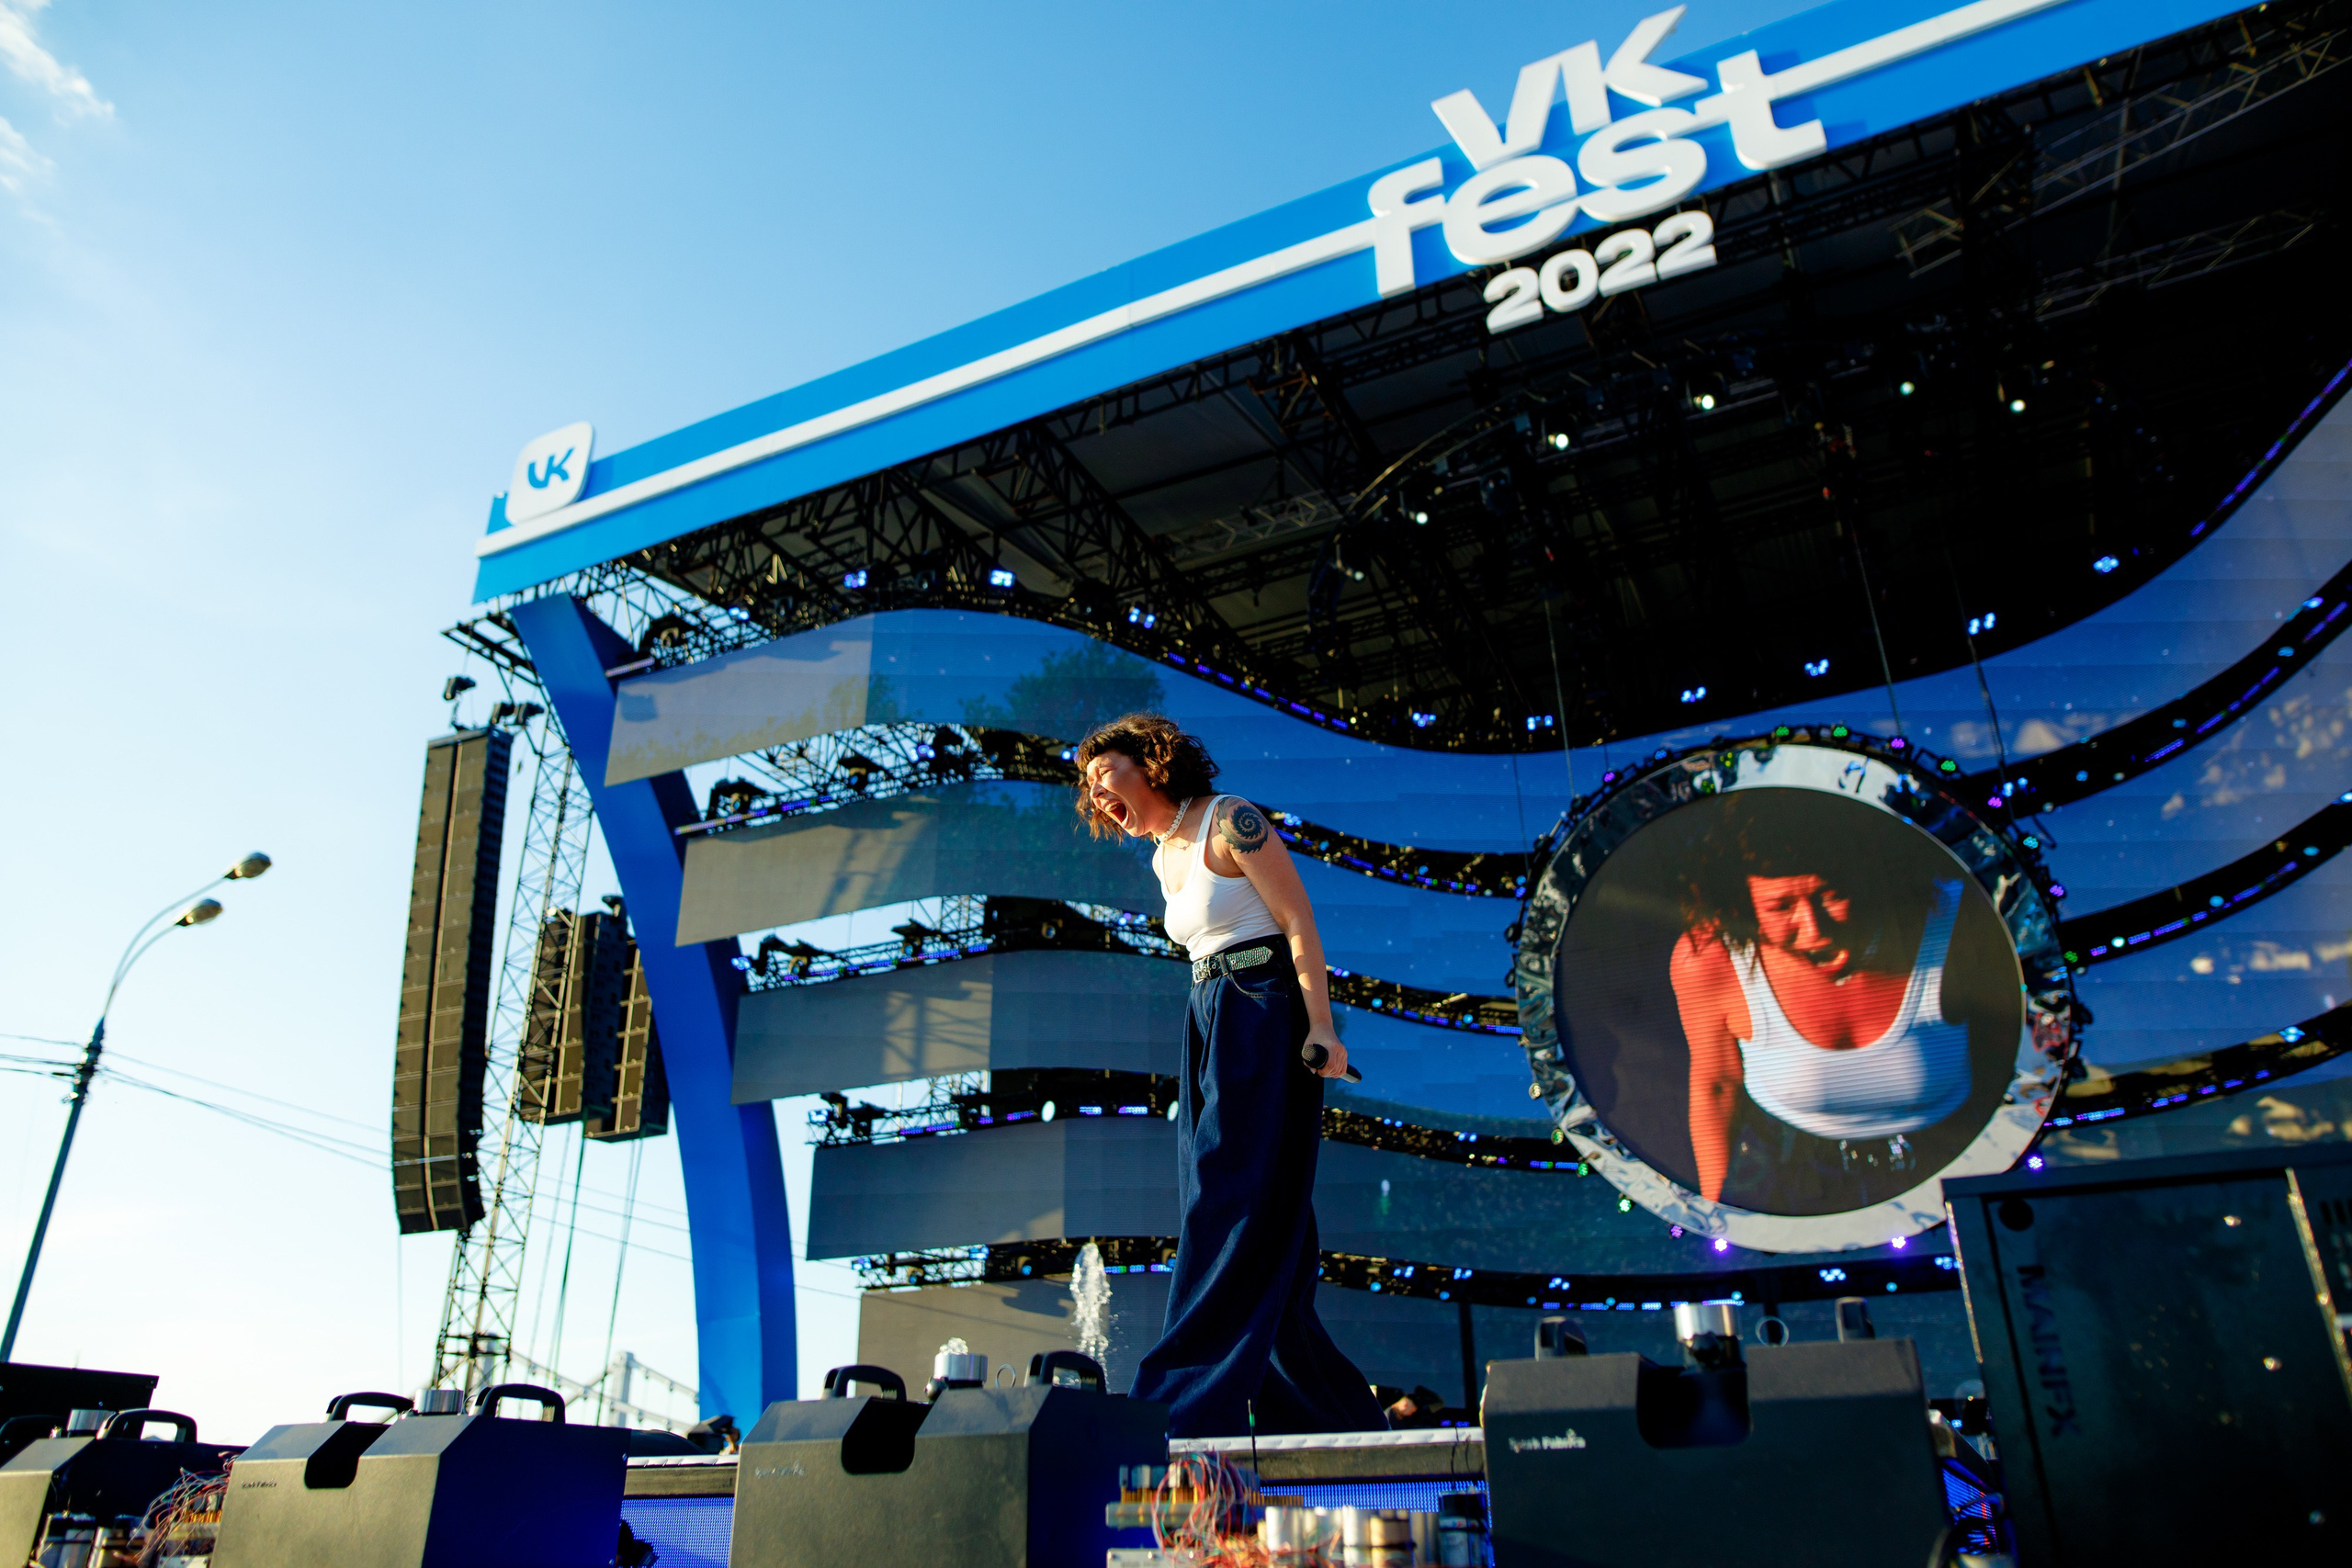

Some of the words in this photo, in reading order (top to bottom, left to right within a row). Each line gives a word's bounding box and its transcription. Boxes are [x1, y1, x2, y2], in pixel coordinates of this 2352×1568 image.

[1367, 49, 1827, 299] fest
[1482, 210, 1718, 334] 2022
[2017, 1264, 2081, 1438] MAINFX
